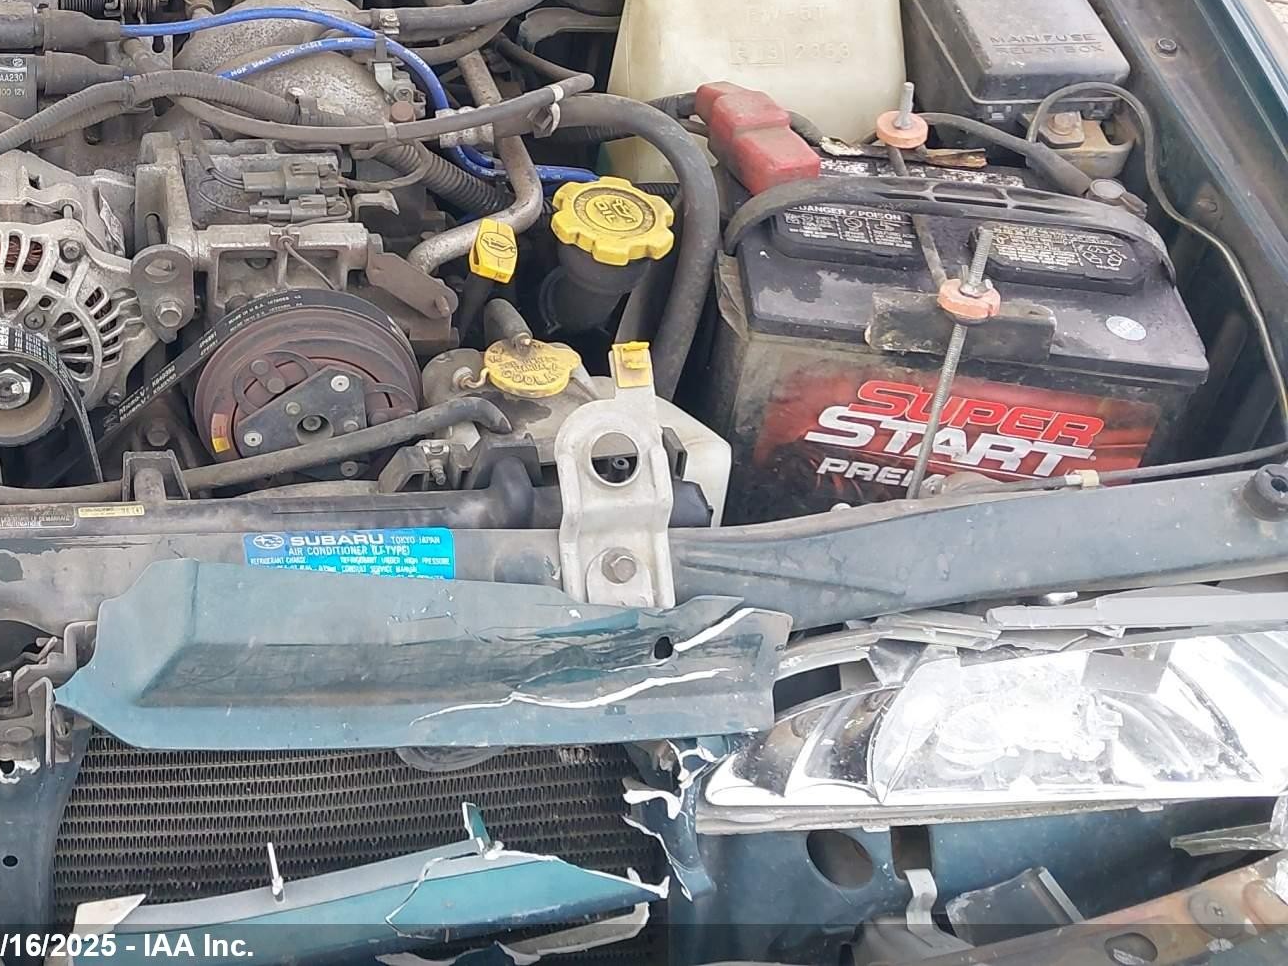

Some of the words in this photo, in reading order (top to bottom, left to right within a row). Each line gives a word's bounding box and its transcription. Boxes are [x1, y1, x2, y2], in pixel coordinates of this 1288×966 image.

[594, 200, 617, 224] OIL
[857, 210, 902, 221] POISON
[848, 380, 1105, 447] SUPER
[804, 405, 1096, 479] START
[290, 534, 385, 546] SUBARU
[418, 536, 441, 545] JAPAN
[288, 546, 304, 556] AIR
[306, 545, 368, 556] CONDITIONER
